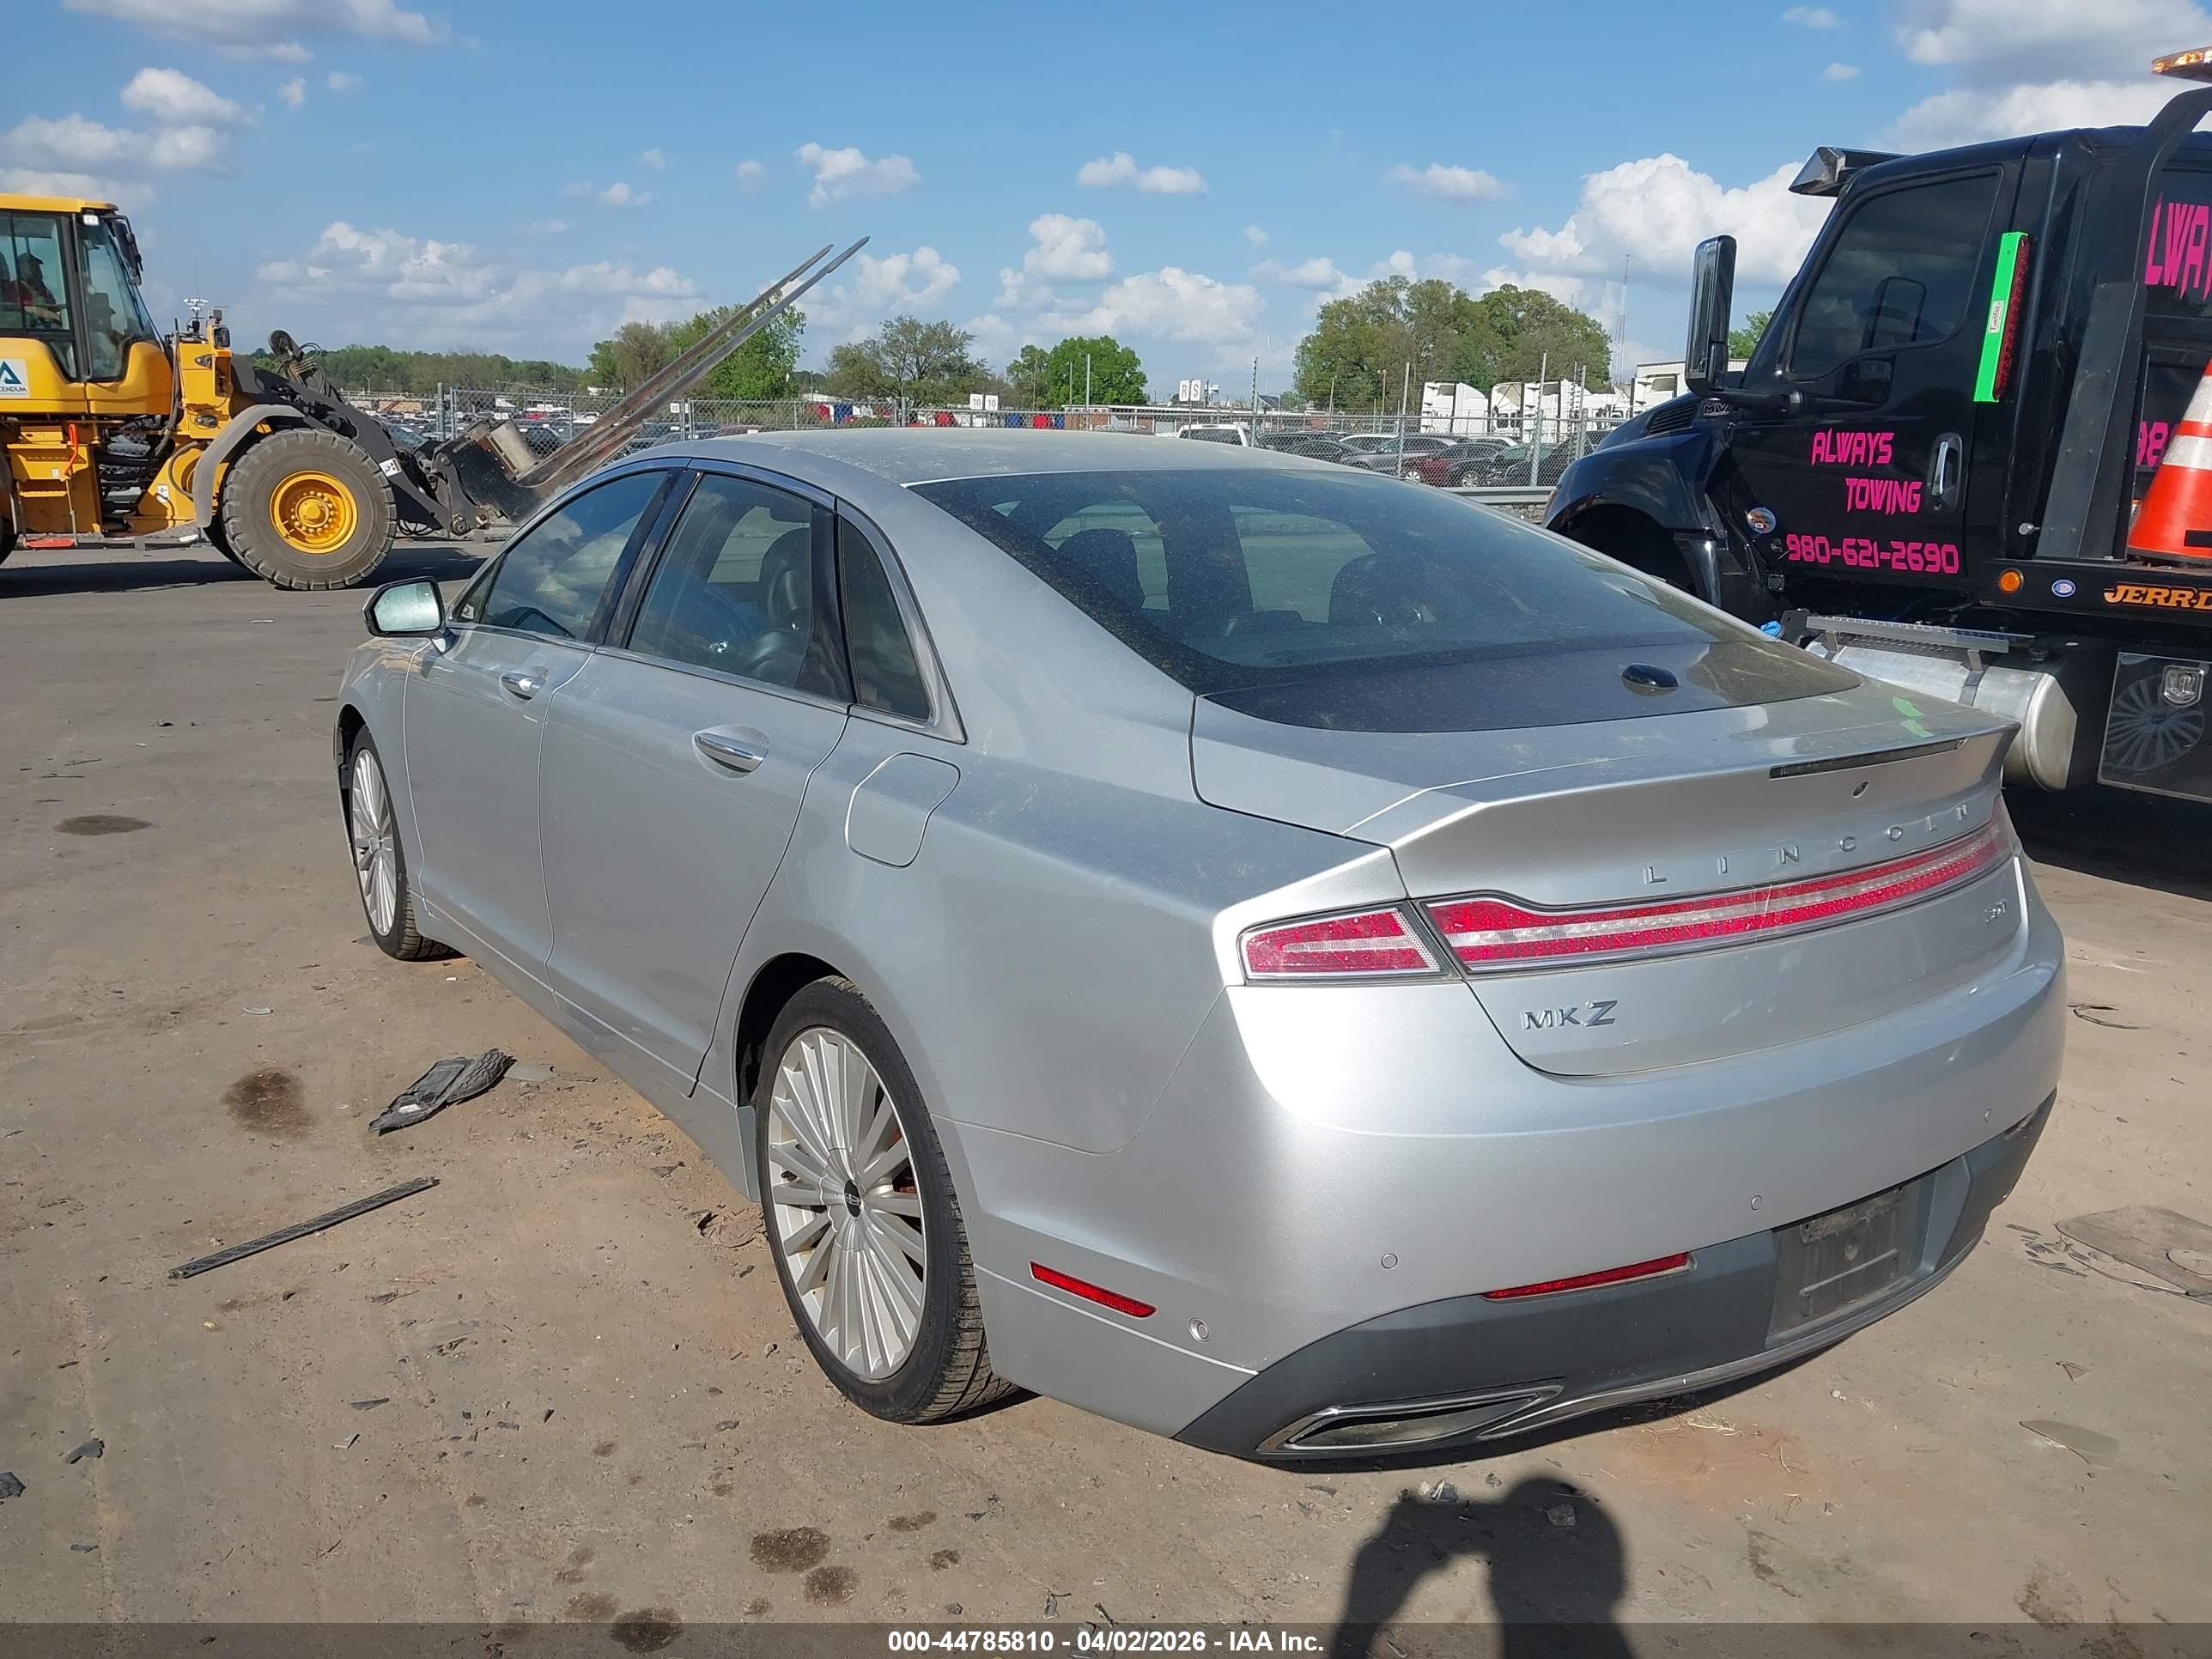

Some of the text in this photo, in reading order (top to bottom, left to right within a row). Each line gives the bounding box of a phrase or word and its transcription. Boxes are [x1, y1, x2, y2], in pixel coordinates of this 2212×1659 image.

[2144, 191, 2212, 302] LWA
[972, 398, 981, 406] 10
[988, 398, 996, 408] 10
[1181, 384, 1188, 398] R
[1193, 383, 1200, 398] S
[1811, 428, 1895, 467] ALWAYS
[1845, 477, 1923, 515] TOWING
[1787, 534, 1960, 574] 980-621-2690
[1643, 804, 1969, 885] LINCOLN
[1520, 1000, 1619, 1030] MKZ
